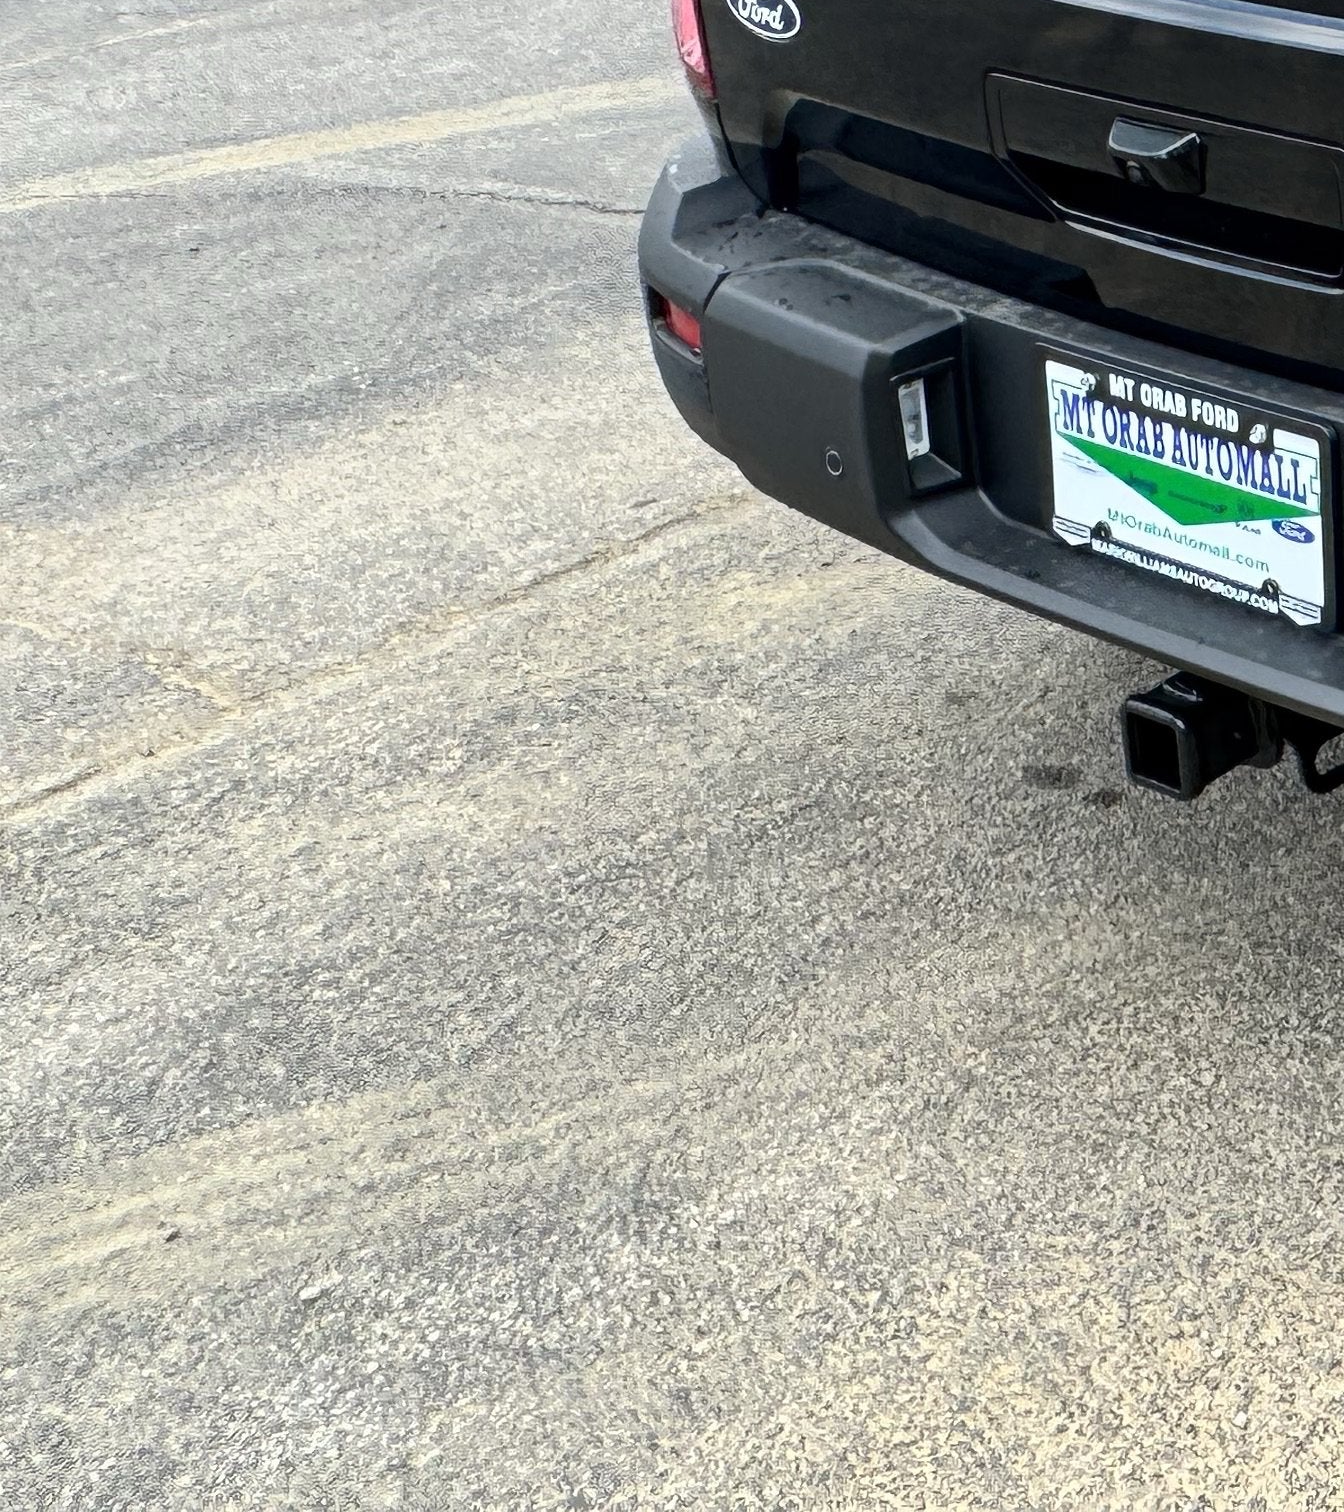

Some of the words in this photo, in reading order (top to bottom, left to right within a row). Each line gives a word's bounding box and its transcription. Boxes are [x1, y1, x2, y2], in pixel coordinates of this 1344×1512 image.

[1060, 389, 1096, 439] MT
[1102, 401, 1166, 460] ORAB
[1172, 424, 1307, 505] AUTOMALL
[1109, 373, 1135, 402] MT
[1140, 383, 1187, 418] ORAB
[1191, 398, 1239, 433] FORD
